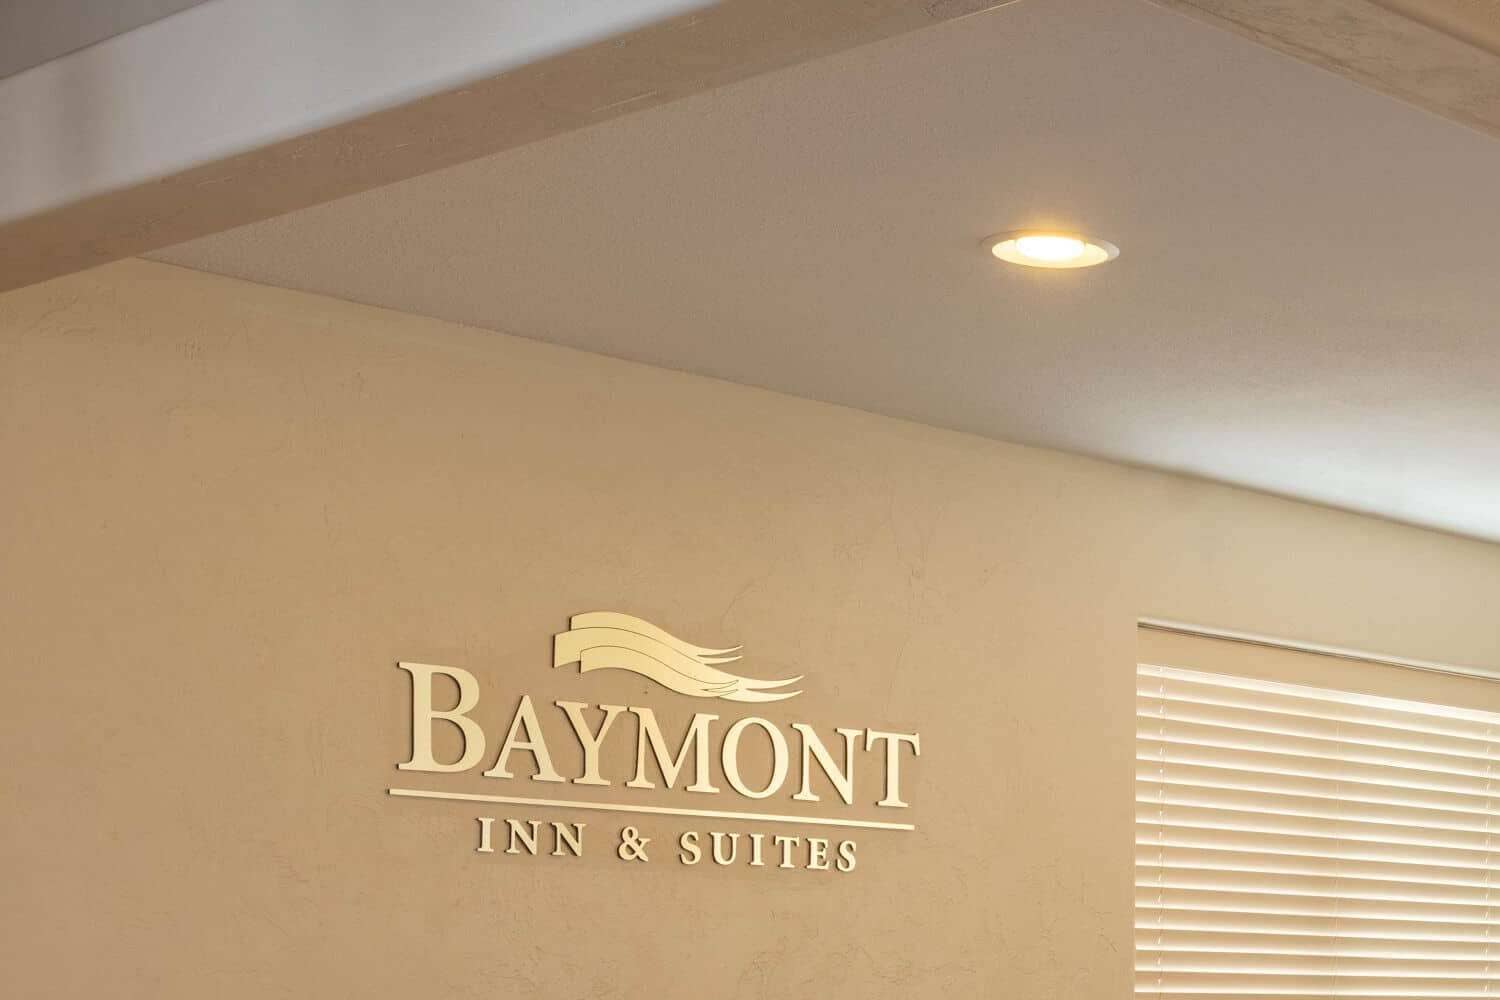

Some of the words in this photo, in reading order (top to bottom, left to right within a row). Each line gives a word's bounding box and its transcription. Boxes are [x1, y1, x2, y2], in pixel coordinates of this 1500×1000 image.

[397, 661, 921, 809] BAYMONT
[475, 816, 587, 858] INN
[618, 825, 652, 863] &
[679, 830, 858, 873] SUITES
